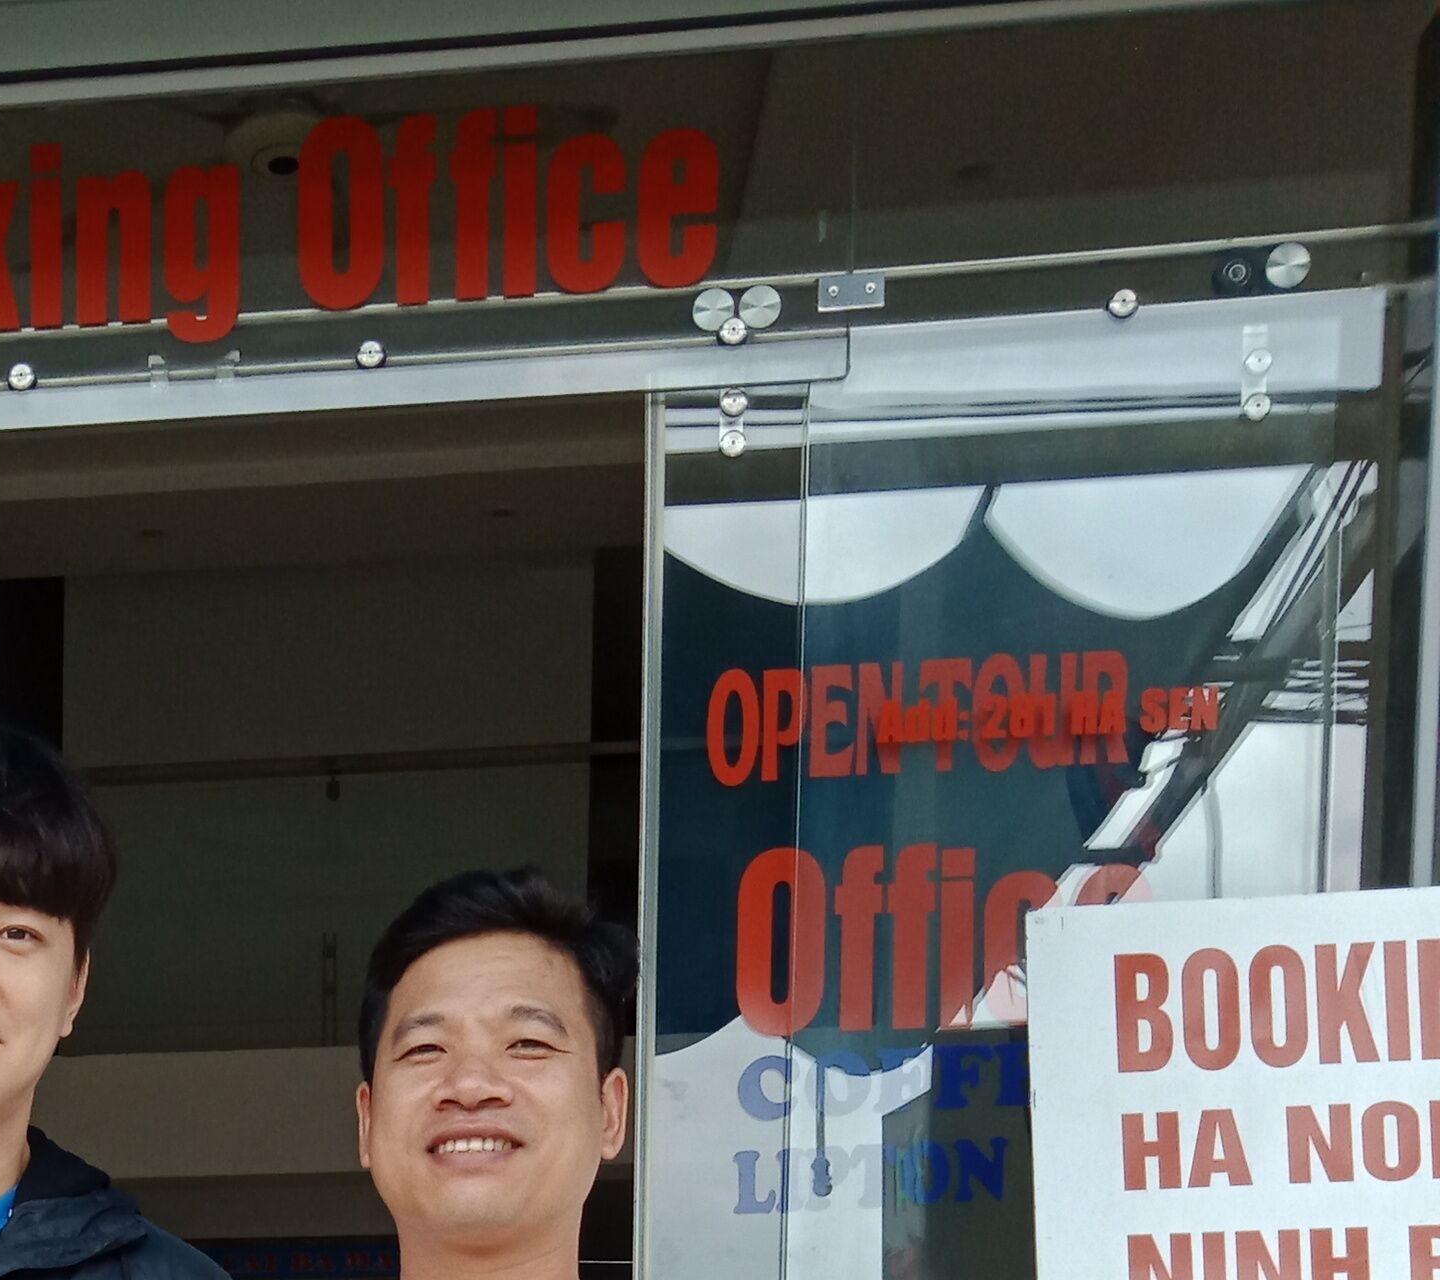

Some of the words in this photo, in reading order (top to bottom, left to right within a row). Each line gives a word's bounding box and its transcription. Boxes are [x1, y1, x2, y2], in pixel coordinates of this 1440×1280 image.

[298, 104, 720, 311] Office
[706, 661, 903, 787] OPEN
[1140, 686, 1220, 735] SEN
[736, 843, 1153, 1038] Offic
[733, 1136, 1008, 1214] LIPTON
[1121, 1107, 1253, 1191] HA
